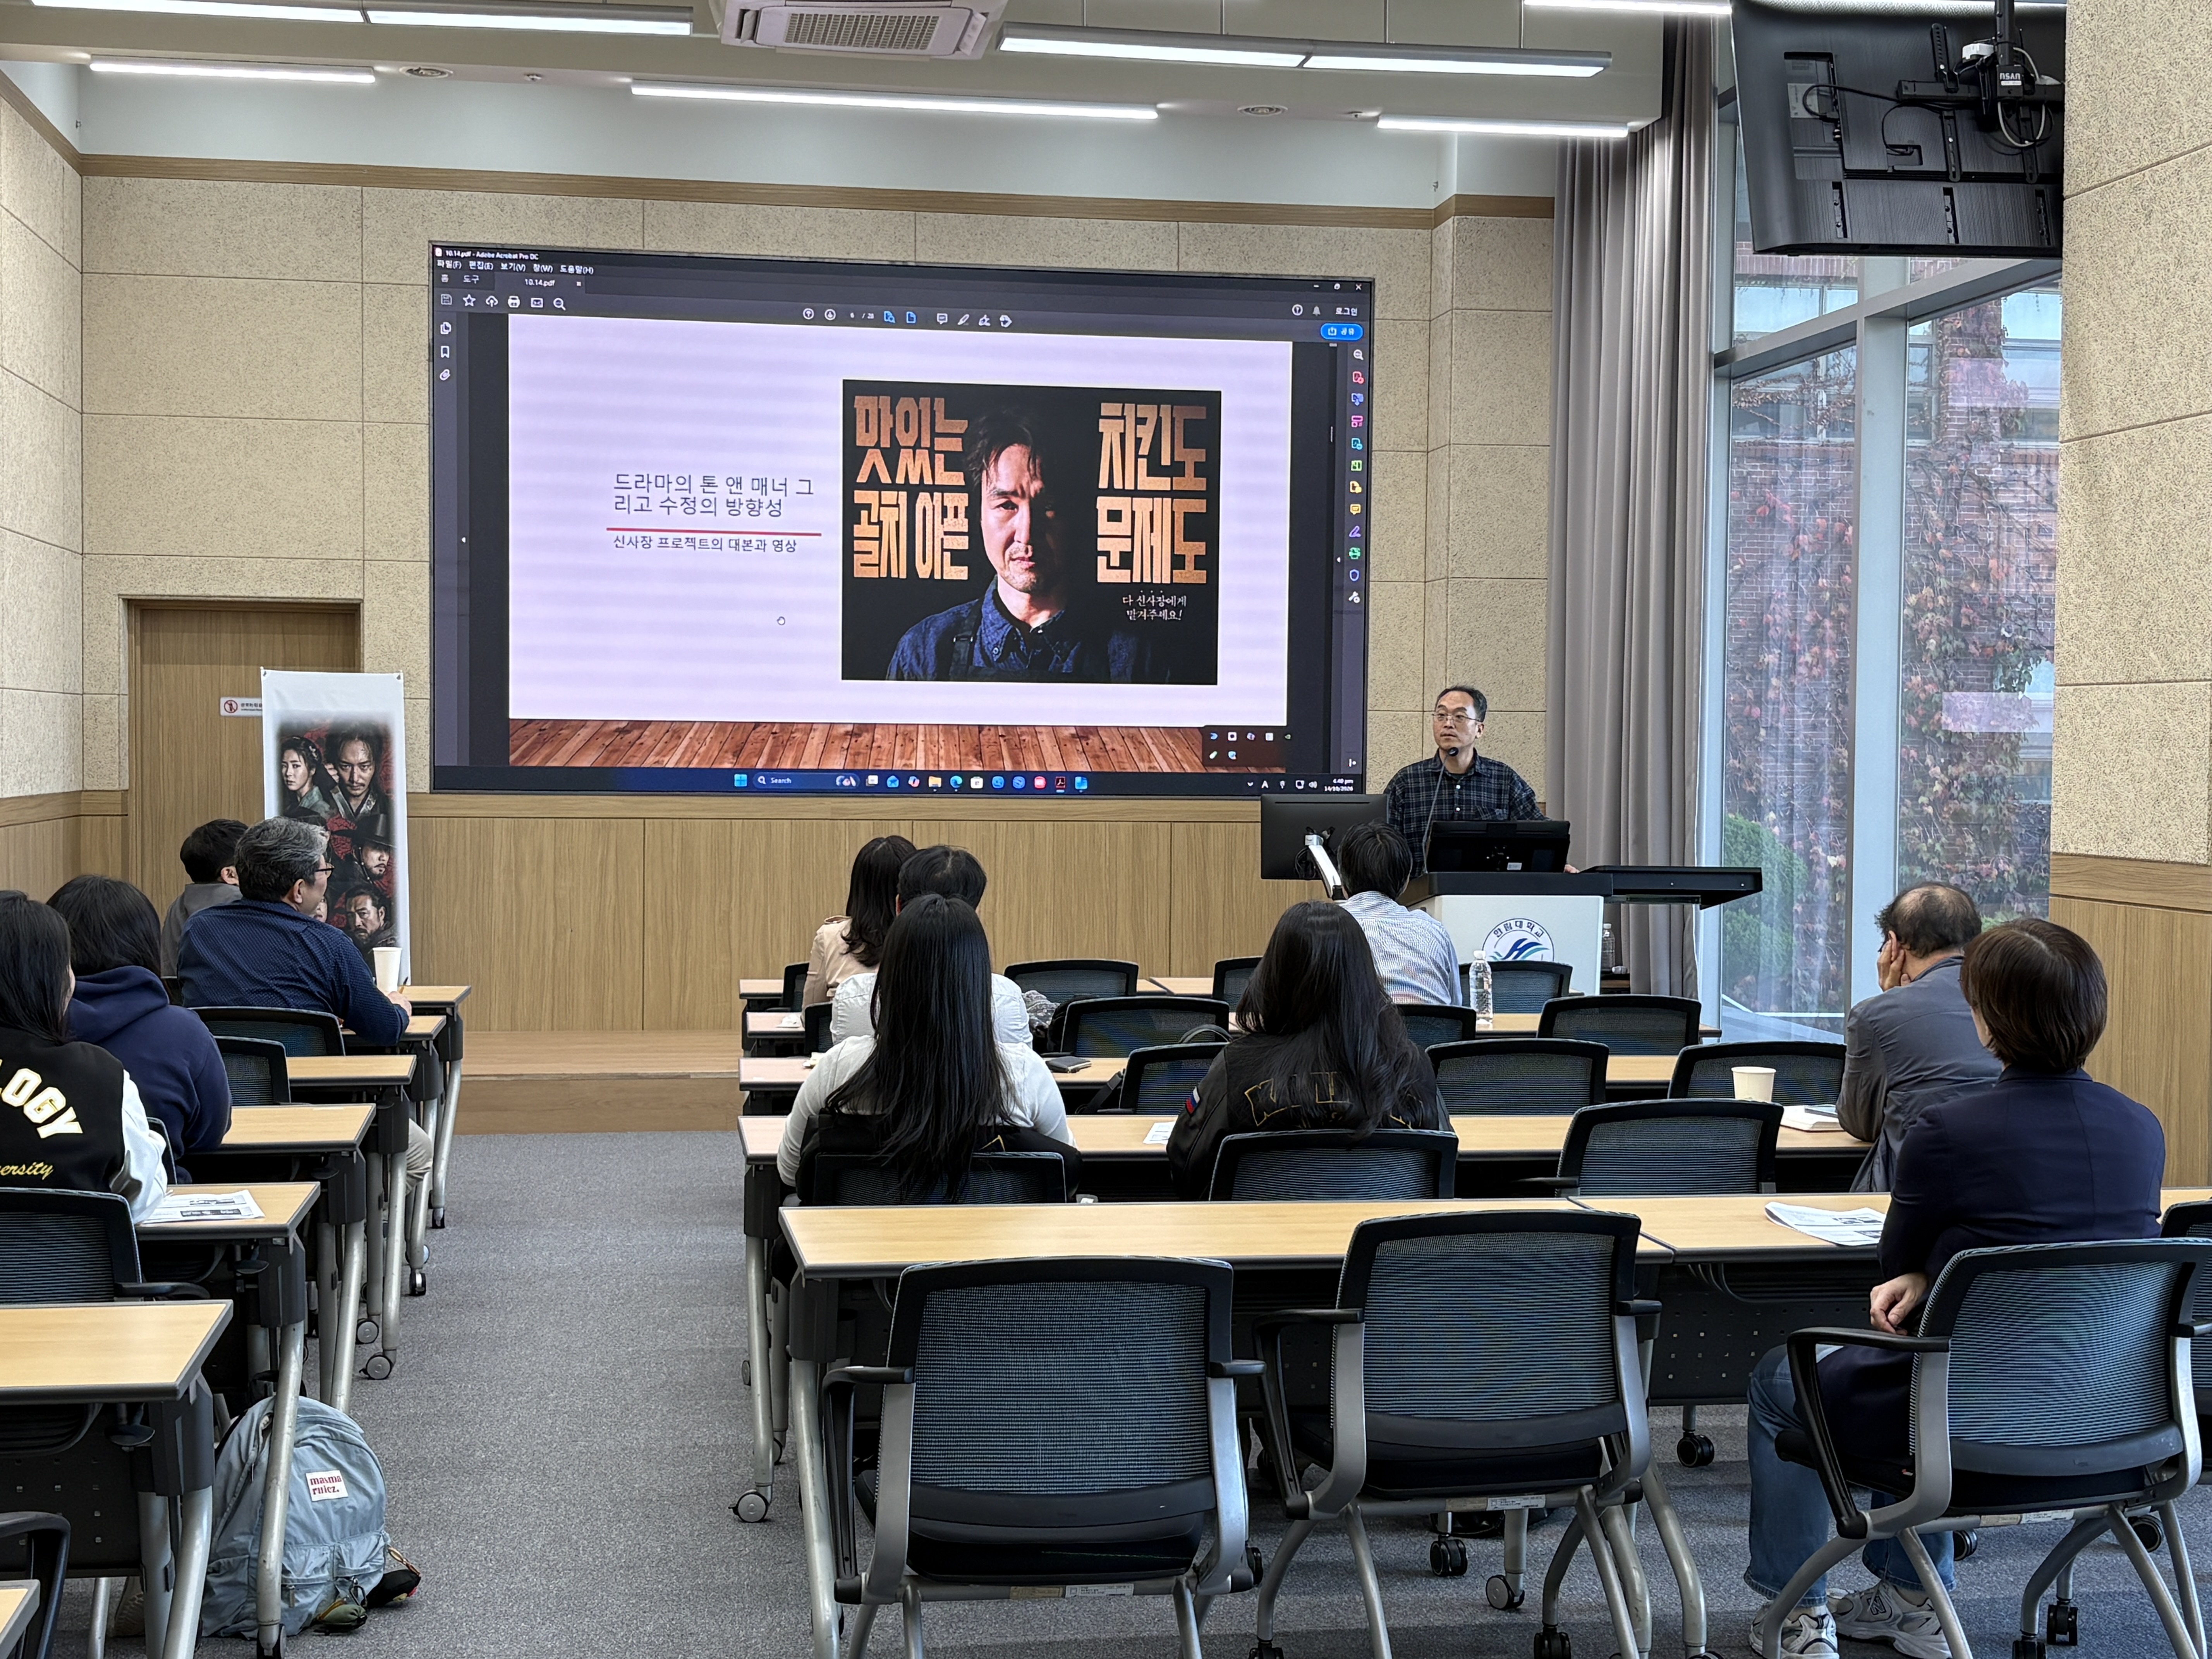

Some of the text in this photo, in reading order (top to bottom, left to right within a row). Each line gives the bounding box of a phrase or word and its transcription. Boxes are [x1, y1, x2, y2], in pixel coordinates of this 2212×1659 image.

[437, 260, 462, 270] 파일(F)
[469, 261, 494, 270] 편집(E)
[501, 262, 526, 272] 보기(V)
[463, 275, 479, 285] 도구
[525, 278, 555, 288] 10.14.pdf
[854, 396, 968, 486] 맛있는
[1098, 402, 1207, 491] 치킨도
[614, 474, 814, 497] 드라마의 톤 앤 매너 그
[614, 494, 782, 517] 리고 수정의 방향성
[613, 535, 797, 553] 신사장 프로젝트의 대본과 영상
[854, 490, 969, 580] 골치 아픈
[1096, 496, 1207, 584] 문제도
[1123, 594, 1187, 607] 다 신사장에게
[0, 1060, 83, 1139] OGY
